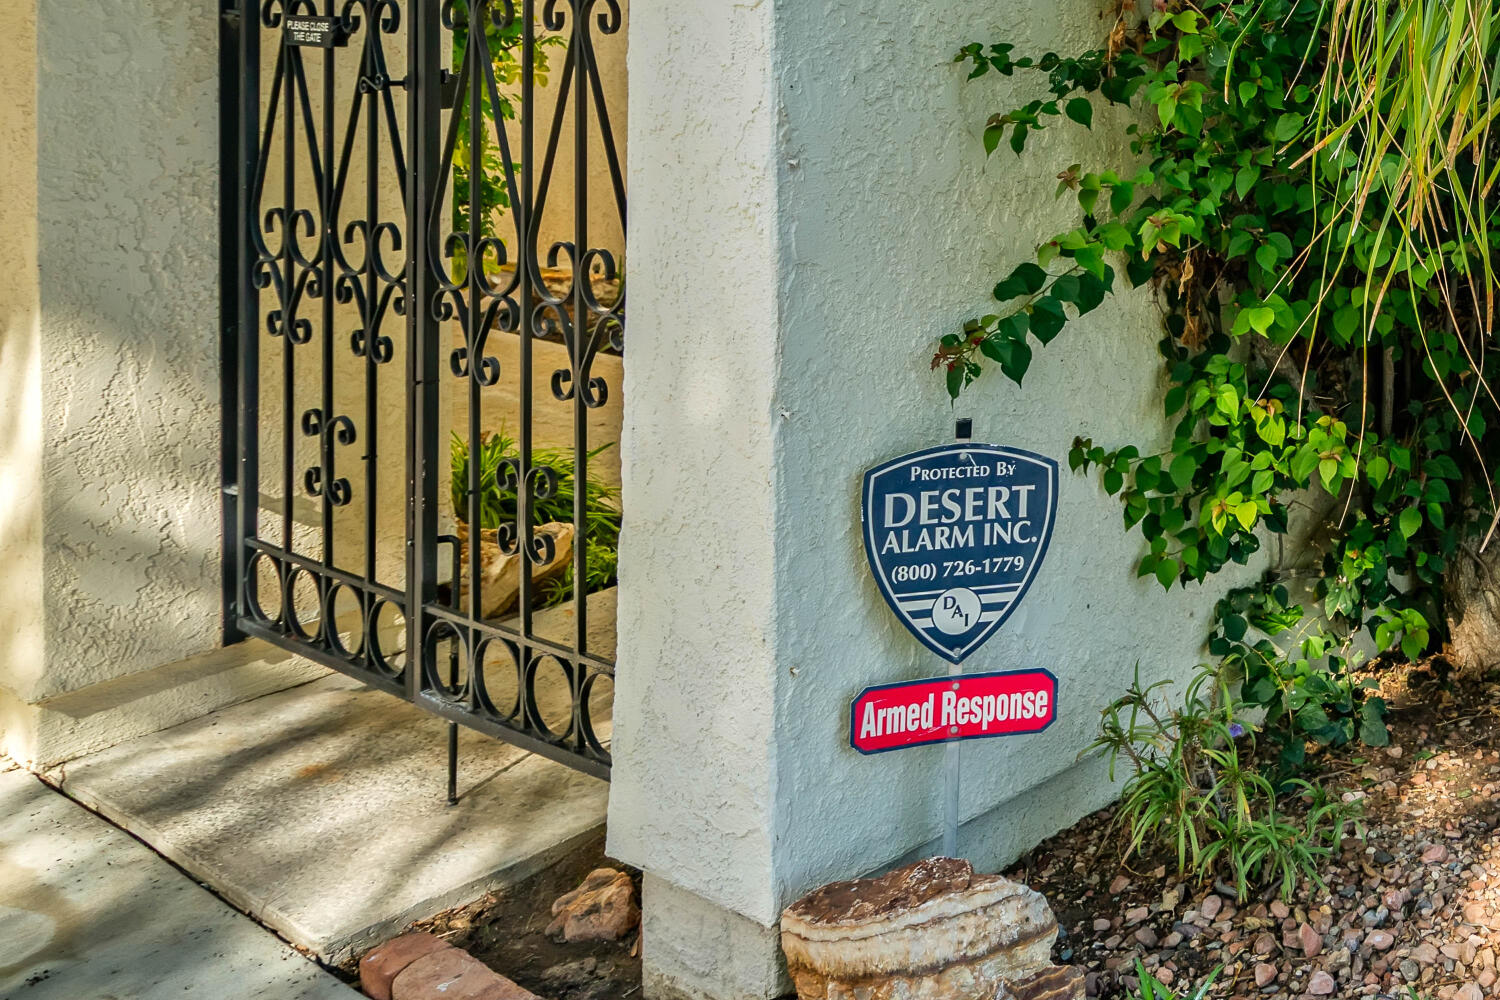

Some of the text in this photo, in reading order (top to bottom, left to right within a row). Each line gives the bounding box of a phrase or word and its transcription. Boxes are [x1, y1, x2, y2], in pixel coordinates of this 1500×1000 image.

[287, 20, 329, 32] PLEASE CLOSE
[293, 31, 322, 43] THE GATE
[884, 484, 1036, 528] DESERT
[881, 520, 1038, 555] ALARM INC.
[891, 555, 1025, 584] (800) 726-1779
[943, 595, 969, 627] DAI
[860, 690, 1049, 739] Armed Response
